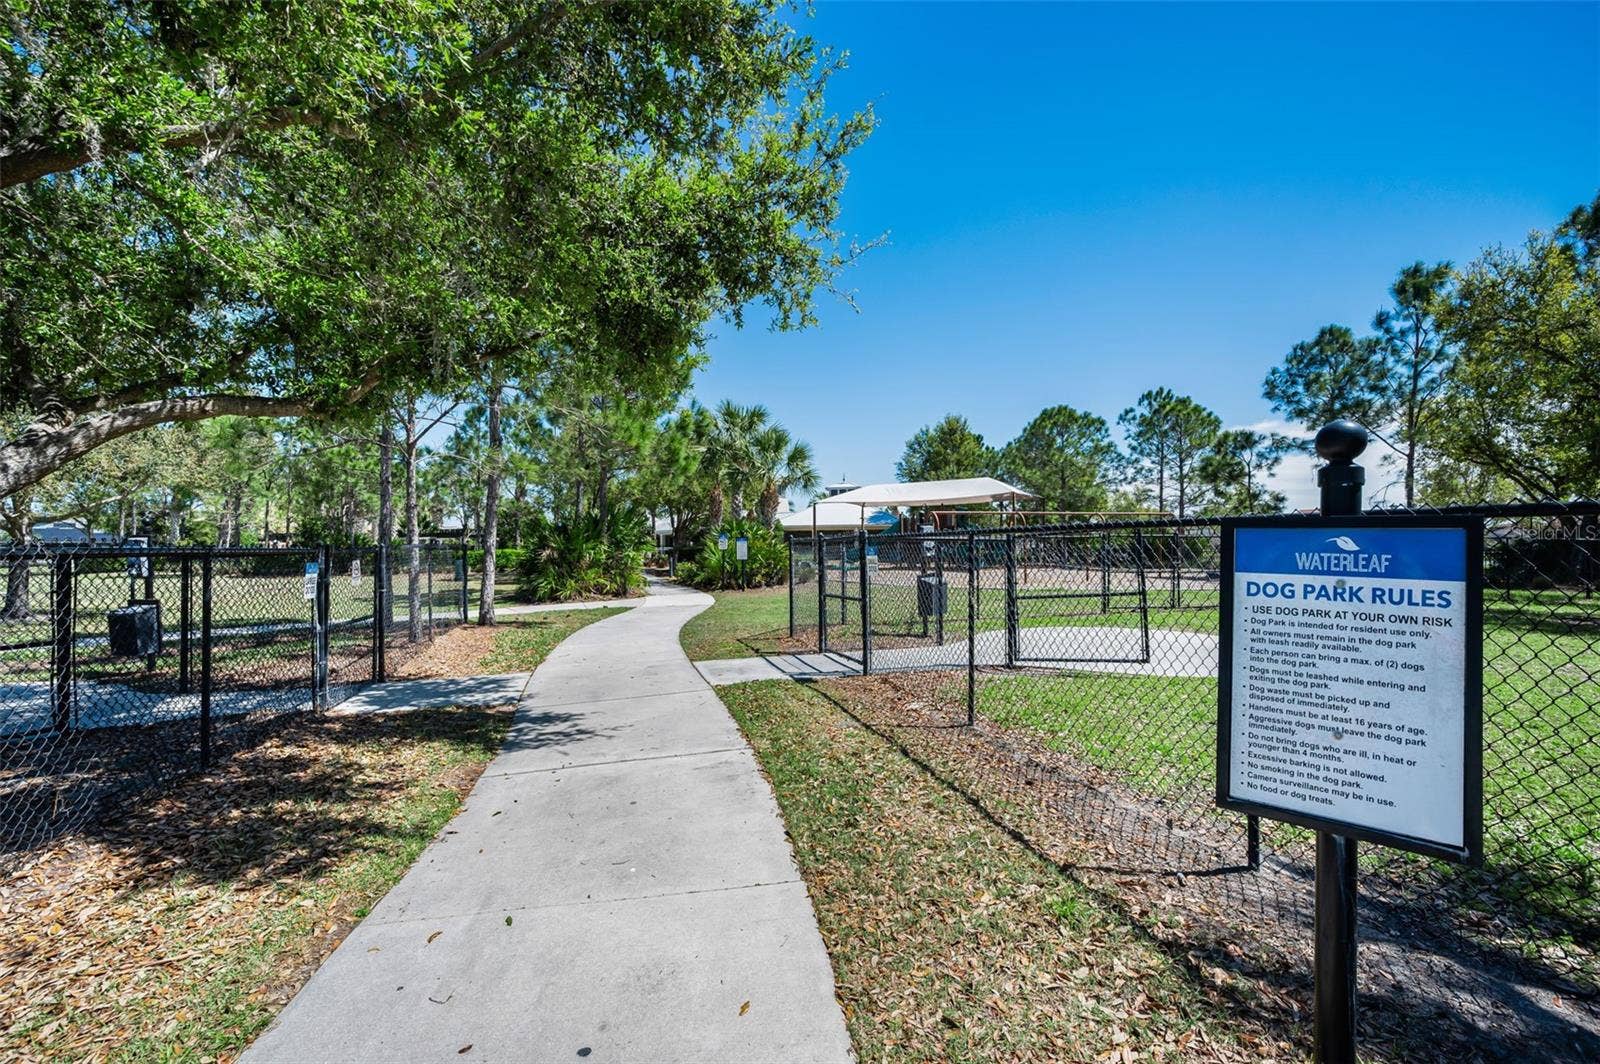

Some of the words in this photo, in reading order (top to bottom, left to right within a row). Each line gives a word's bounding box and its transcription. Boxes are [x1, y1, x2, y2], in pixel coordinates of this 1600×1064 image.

[1296, 552, 1392, 573] WATERLEAF
[1246, 581, 1295, 599] DOG
[1303, 584, 1364, 604] PARK
[1372, 588, 1452, 608] RULES
[1252, 606, 1272, 614] USE
[1276, 607, 1298, 616] DOG
[1302, 609, 1331, 618] PARK
[1334, 611, 1348, 619] AT
[1352, 612, 1385, 622] YOUR
[1389, 614, 1418, 624] OWN
[1422, 617, 1452, 627] RISK
[1251, 618, 1266, 626] Dog
[1298, 620, 1333, 630] intended
[1351, 625, 1387, 634] resident
[1409, 630, 1432, 639] only.
[1263, 630, 1291, 638] owners
[1317, 634, 1345, 642] remain
[1359, 637, 1372, 645] the
[1375, 639, 1393, 648] dog
[1396, 641, 1416, 649] park
[1269, 638, 1289, 646] leash
[1292, 641, 1319, 650] readily
[1322, 643, 1362, 653] available.
[1271, 650, 1299, 658] person
[1319, 652, 1340, 664] bring
[1386, 660, 1398, 669] (2)
[1401, 662, 1425, 672] dogs
[1281, 659, 1296, 668] dog
[1299, 661, 1319, 669] park.
[1249, 674, 1275, 684] exiting
[1278, 677, 1290, 685] the
[1293, 679, 1308, 688] dog
[1250, 666, 1269, 674] Dogs
[1272, 668, 1292, 676] must
[1294, 670, 1304, 678] be
[1306, 672, 1339, 682] leashed
[1342, 676, 1364, 685] while
[1367, 680, 1405, 691] entering
[1249, 684, 1264, 693] Dog
[1292, 691, 1313, 699] must
[1328, 696, 1356, 704] picked
[1373, 701, 1390, 709] and
[1249, 694, 1285, 703] disposed
[1297, 699, 1350, 713] immediately.
[1249, 703, 1284, 714] Handlers
[1286, 709, 1306, 717] must
[1331, 715, 1352, 724] least
[1355, 718, 1365, 726] 16
[1368, 722, 1392, 730] years
[1407, 728, 1427, 736] age.
[1249, 723, 1298, 736] immediately.
[1249, 713, 1292, 726] Aggressive
[1295, 720, 1315, 730] dogs
[1318, 723, 1339, 732] must
[1342, 727, 1364, 737] leave
[1368, 731, 1382, 739] the
[1384, 734, 1402, 744] dog
[1405, 738, 1427, 747] park
[1248, 732, 1259, 740] Do
[1276, 737, 1297, 747] bring
[1299, 740, 1320, 750] dogs
[1322, 744, 1340, 753] who
[1359, 750, 1369, 759] ill,
[1384, 755, 1404, 764] heat
[1407, 759, 1417, 767] or
[1248, 742, 1280, 751] younger
[1282, 746, 1300, 755] than
[1308, 751, 1344, 763] months.
[1248, 751, 1287, 764] Excessive
[1290, 758, 1320, 771] barking
[1333, 767, 1347, 775] not
[1350, 769, 1387, 783] allowed.
[1248, 761, 1258, 769] No
[1261, 764, 1294, 777] smoking
[1297, 769, 1304, 777] in
[1307, 771, 1320, 780] the
[1323, 776, 1339, 785] dog
[1342, 780, 1364, 789] park.
[1247, 781, 1258, 790] No
[1260, 784, 1278, 793] food
[1291, 790, 1306, 801] dog
[1309, 795, 1335, 806] treats.
[1248, 771, 1277, 783] Camera
[1280, 778, 1329, 793] surveillance
[1332, 788, 1350, 799] may
[1353, 792, 1363, 800] be
[1366, 794, 1374, 803] in
[1377, 797, 1397, 807] use.
